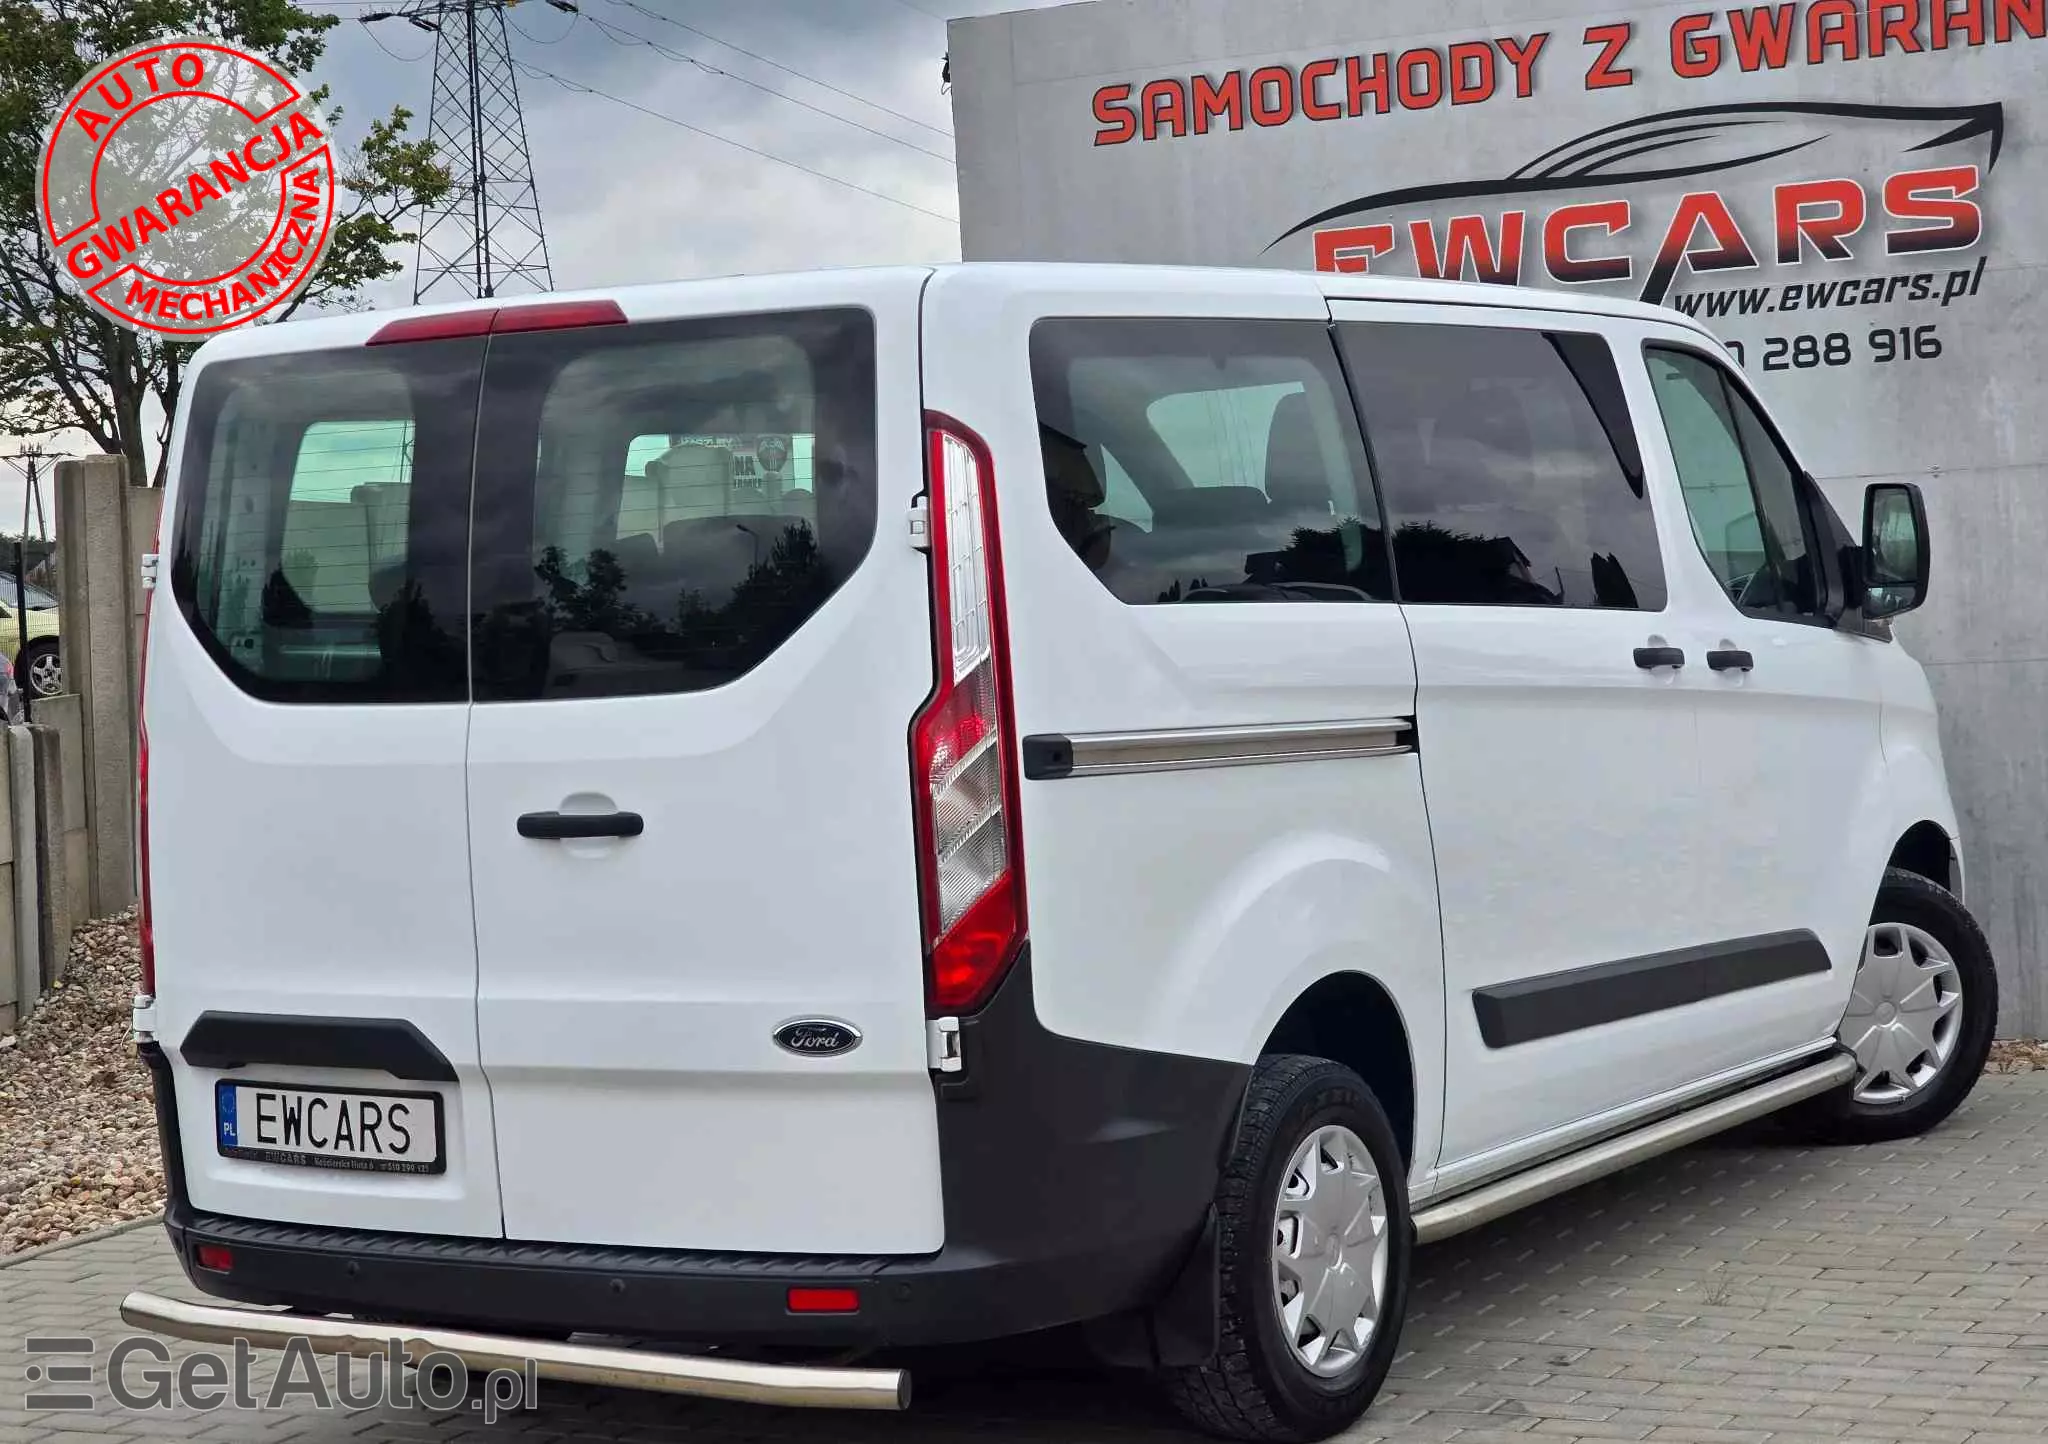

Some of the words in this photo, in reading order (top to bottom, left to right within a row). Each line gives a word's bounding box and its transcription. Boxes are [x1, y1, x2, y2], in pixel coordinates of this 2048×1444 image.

[1092, 32, 1550, 147] SAMOCHODY
[1582, 22, 1633, 91] Z
[1674, 255, 1988, 319] www.ewcars.pl
[1762, 331, 1851, 372] 288
[1868, 324, 1942, 363] 916
[791, 1026, 840, 1048] Ford
[223, 1121, 236, 1137] PL
[255, 1092, 411, 1155] EWCARS
[265, 1151, 307, 1165] EWCARS
